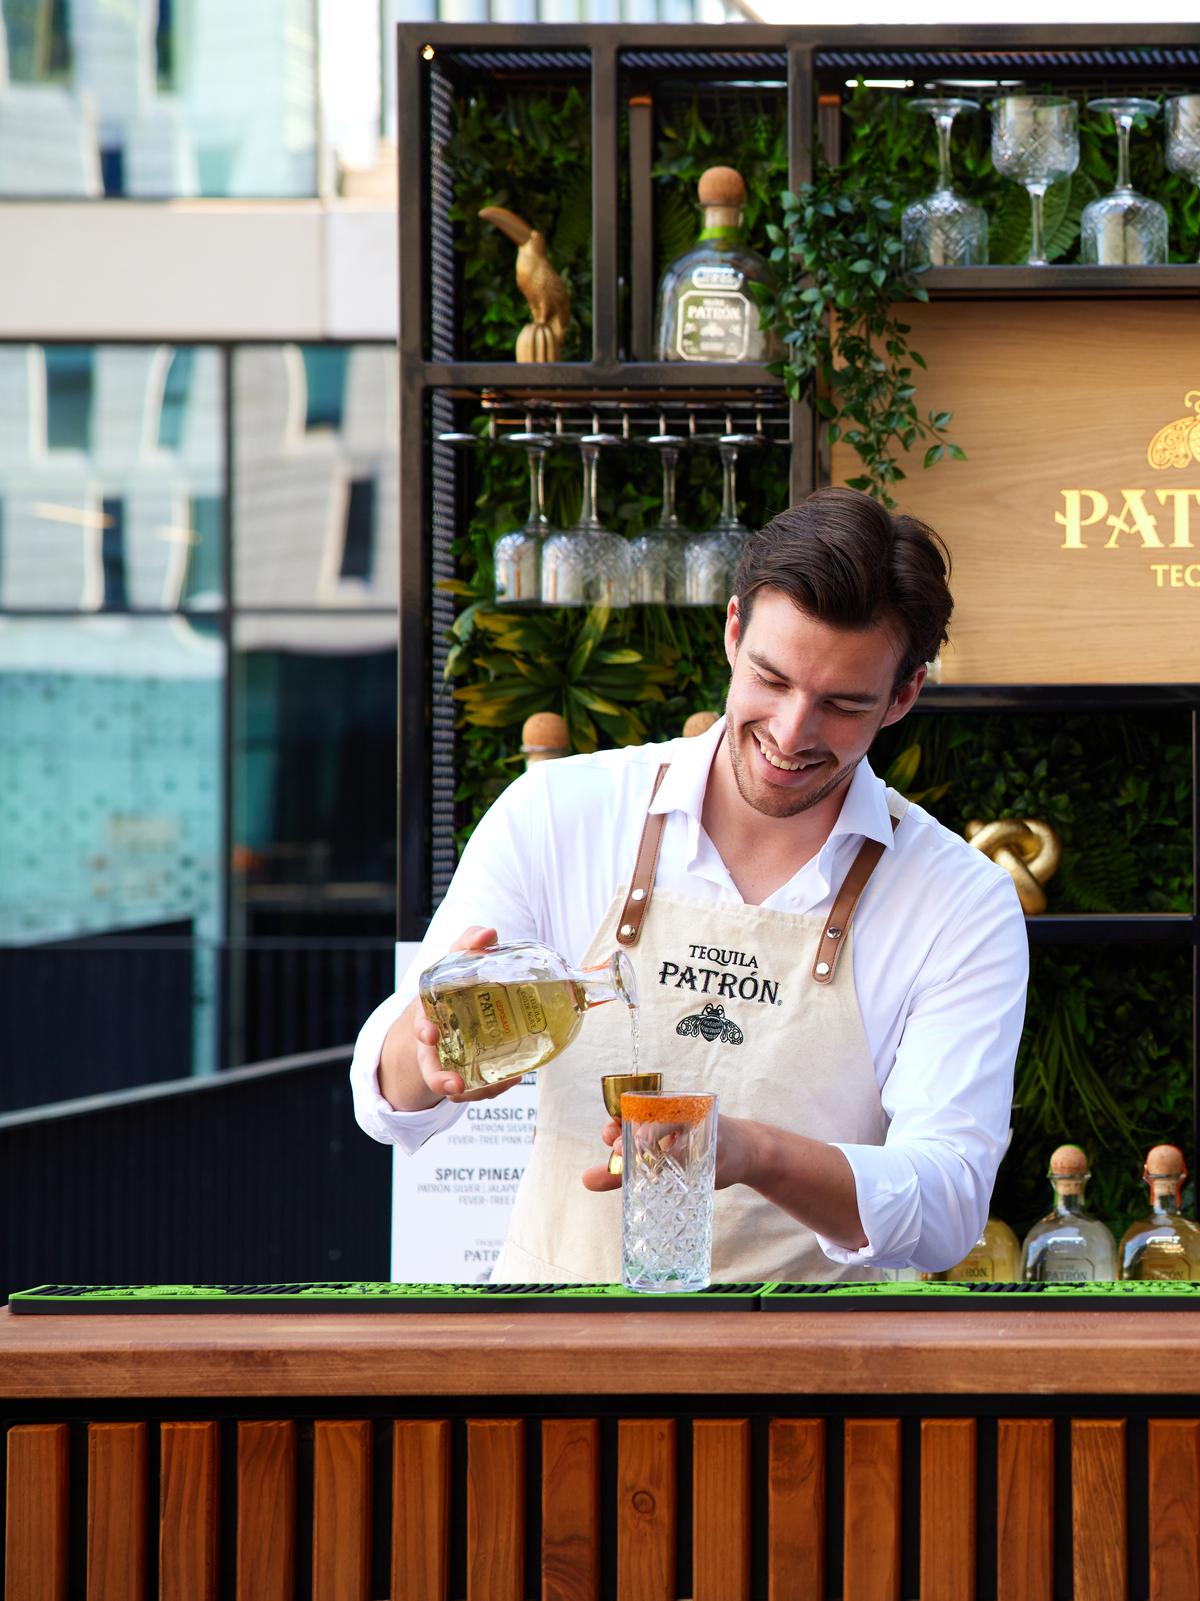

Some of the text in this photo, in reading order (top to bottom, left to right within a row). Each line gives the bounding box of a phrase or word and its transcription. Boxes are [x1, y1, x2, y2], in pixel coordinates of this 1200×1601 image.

[688, 944, 759, 969] TEQUILA
[658, 961, 780, 1005] PATRÓN
[466, 1107, 537, 1120] CLASSIC P
[435, 1168, 474, 1181] SPICY
[464, 1250, 500, 1262] PATR
